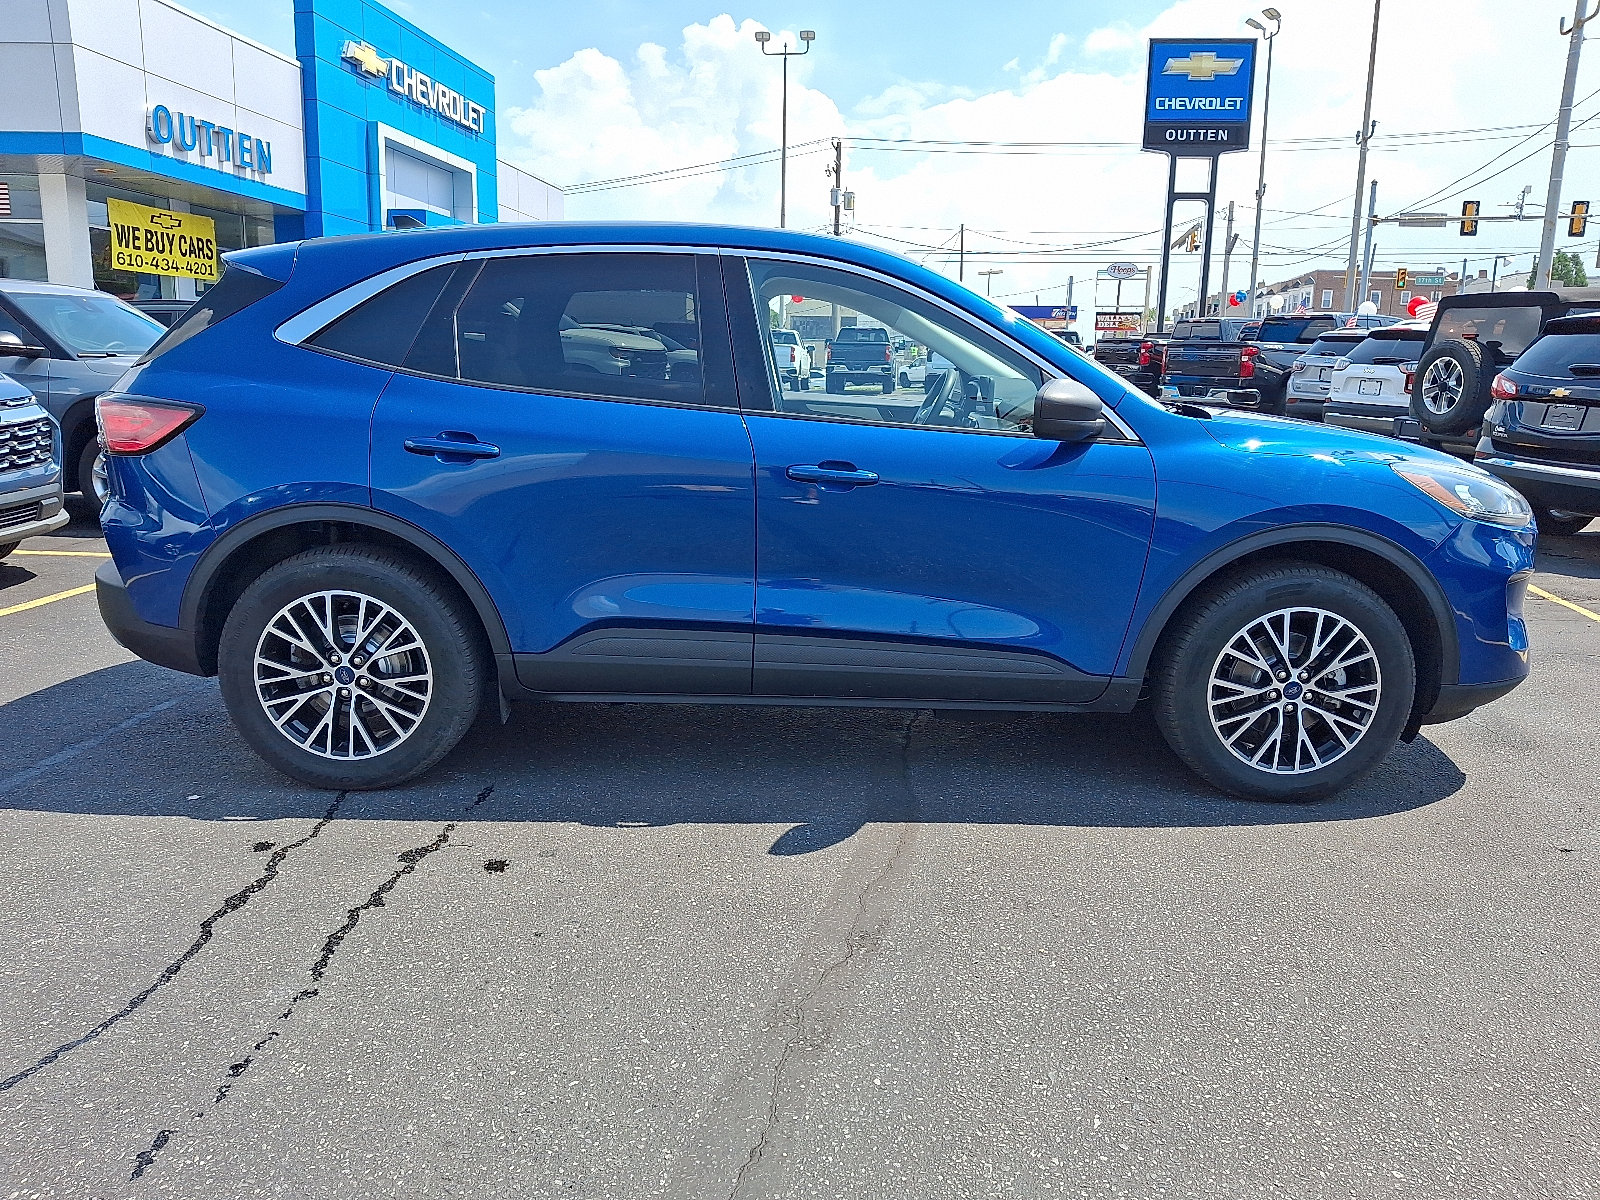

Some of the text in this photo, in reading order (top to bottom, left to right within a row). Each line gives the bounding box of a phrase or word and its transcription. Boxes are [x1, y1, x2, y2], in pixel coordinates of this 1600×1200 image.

[389, 58, 486, 134] CHEVROLET
[1155, 97, 1244, 110] CHEVROLET
[150, 104, 272, 175] OUTTEN
[1165, 129, 1228, 141] OUTTEN
[114, 223, 214, 260] WE BUY CARS
[116, 252, 215, 276] 610-434-4201
